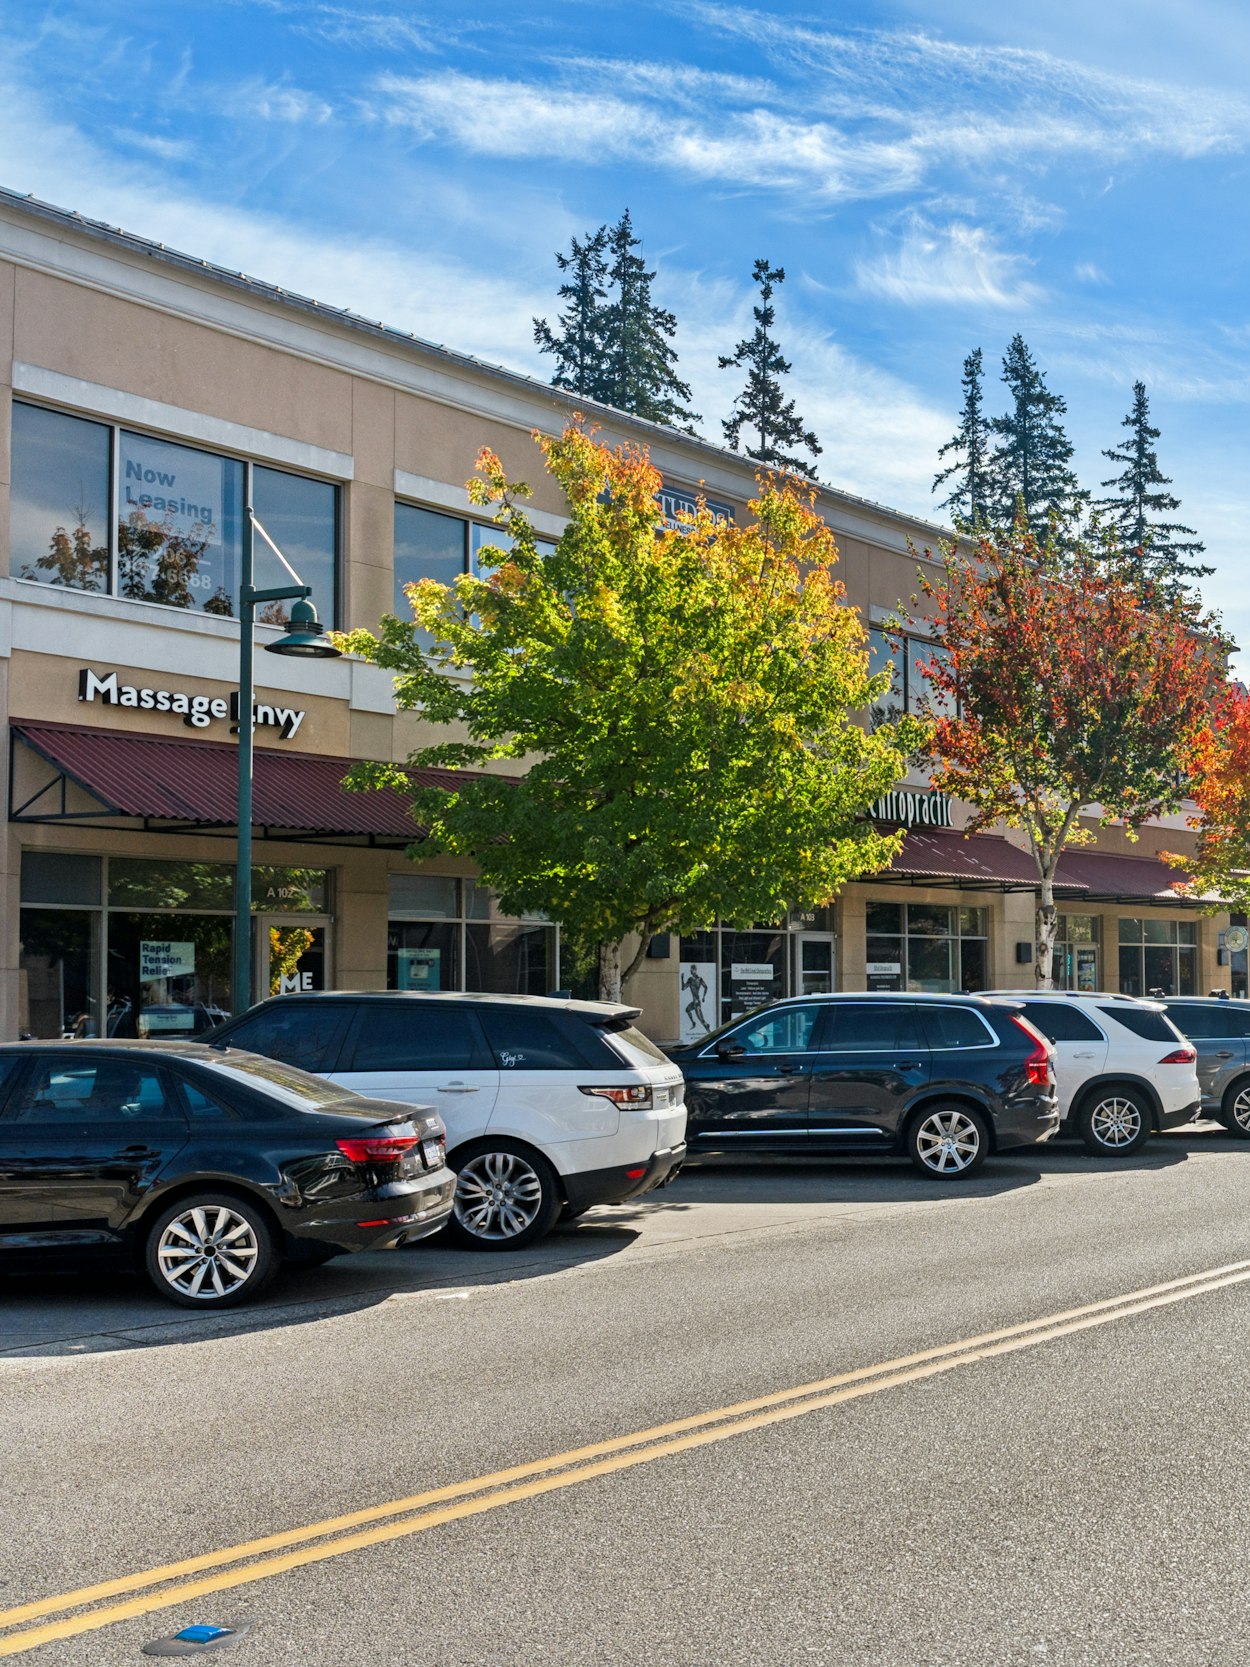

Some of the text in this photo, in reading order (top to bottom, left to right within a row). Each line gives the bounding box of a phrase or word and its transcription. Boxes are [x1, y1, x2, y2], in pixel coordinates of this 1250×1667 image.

[125, 460, 176, 488] Now
[126, 485, 213, 526] Leasing
[78, 668, 228, 728] Massage
[266, 887, 276, 898] A
[142, 943, 171, 954] Rapid
[142, 955, 182, 965] Tension
[280, 971, 313, 995] ME
